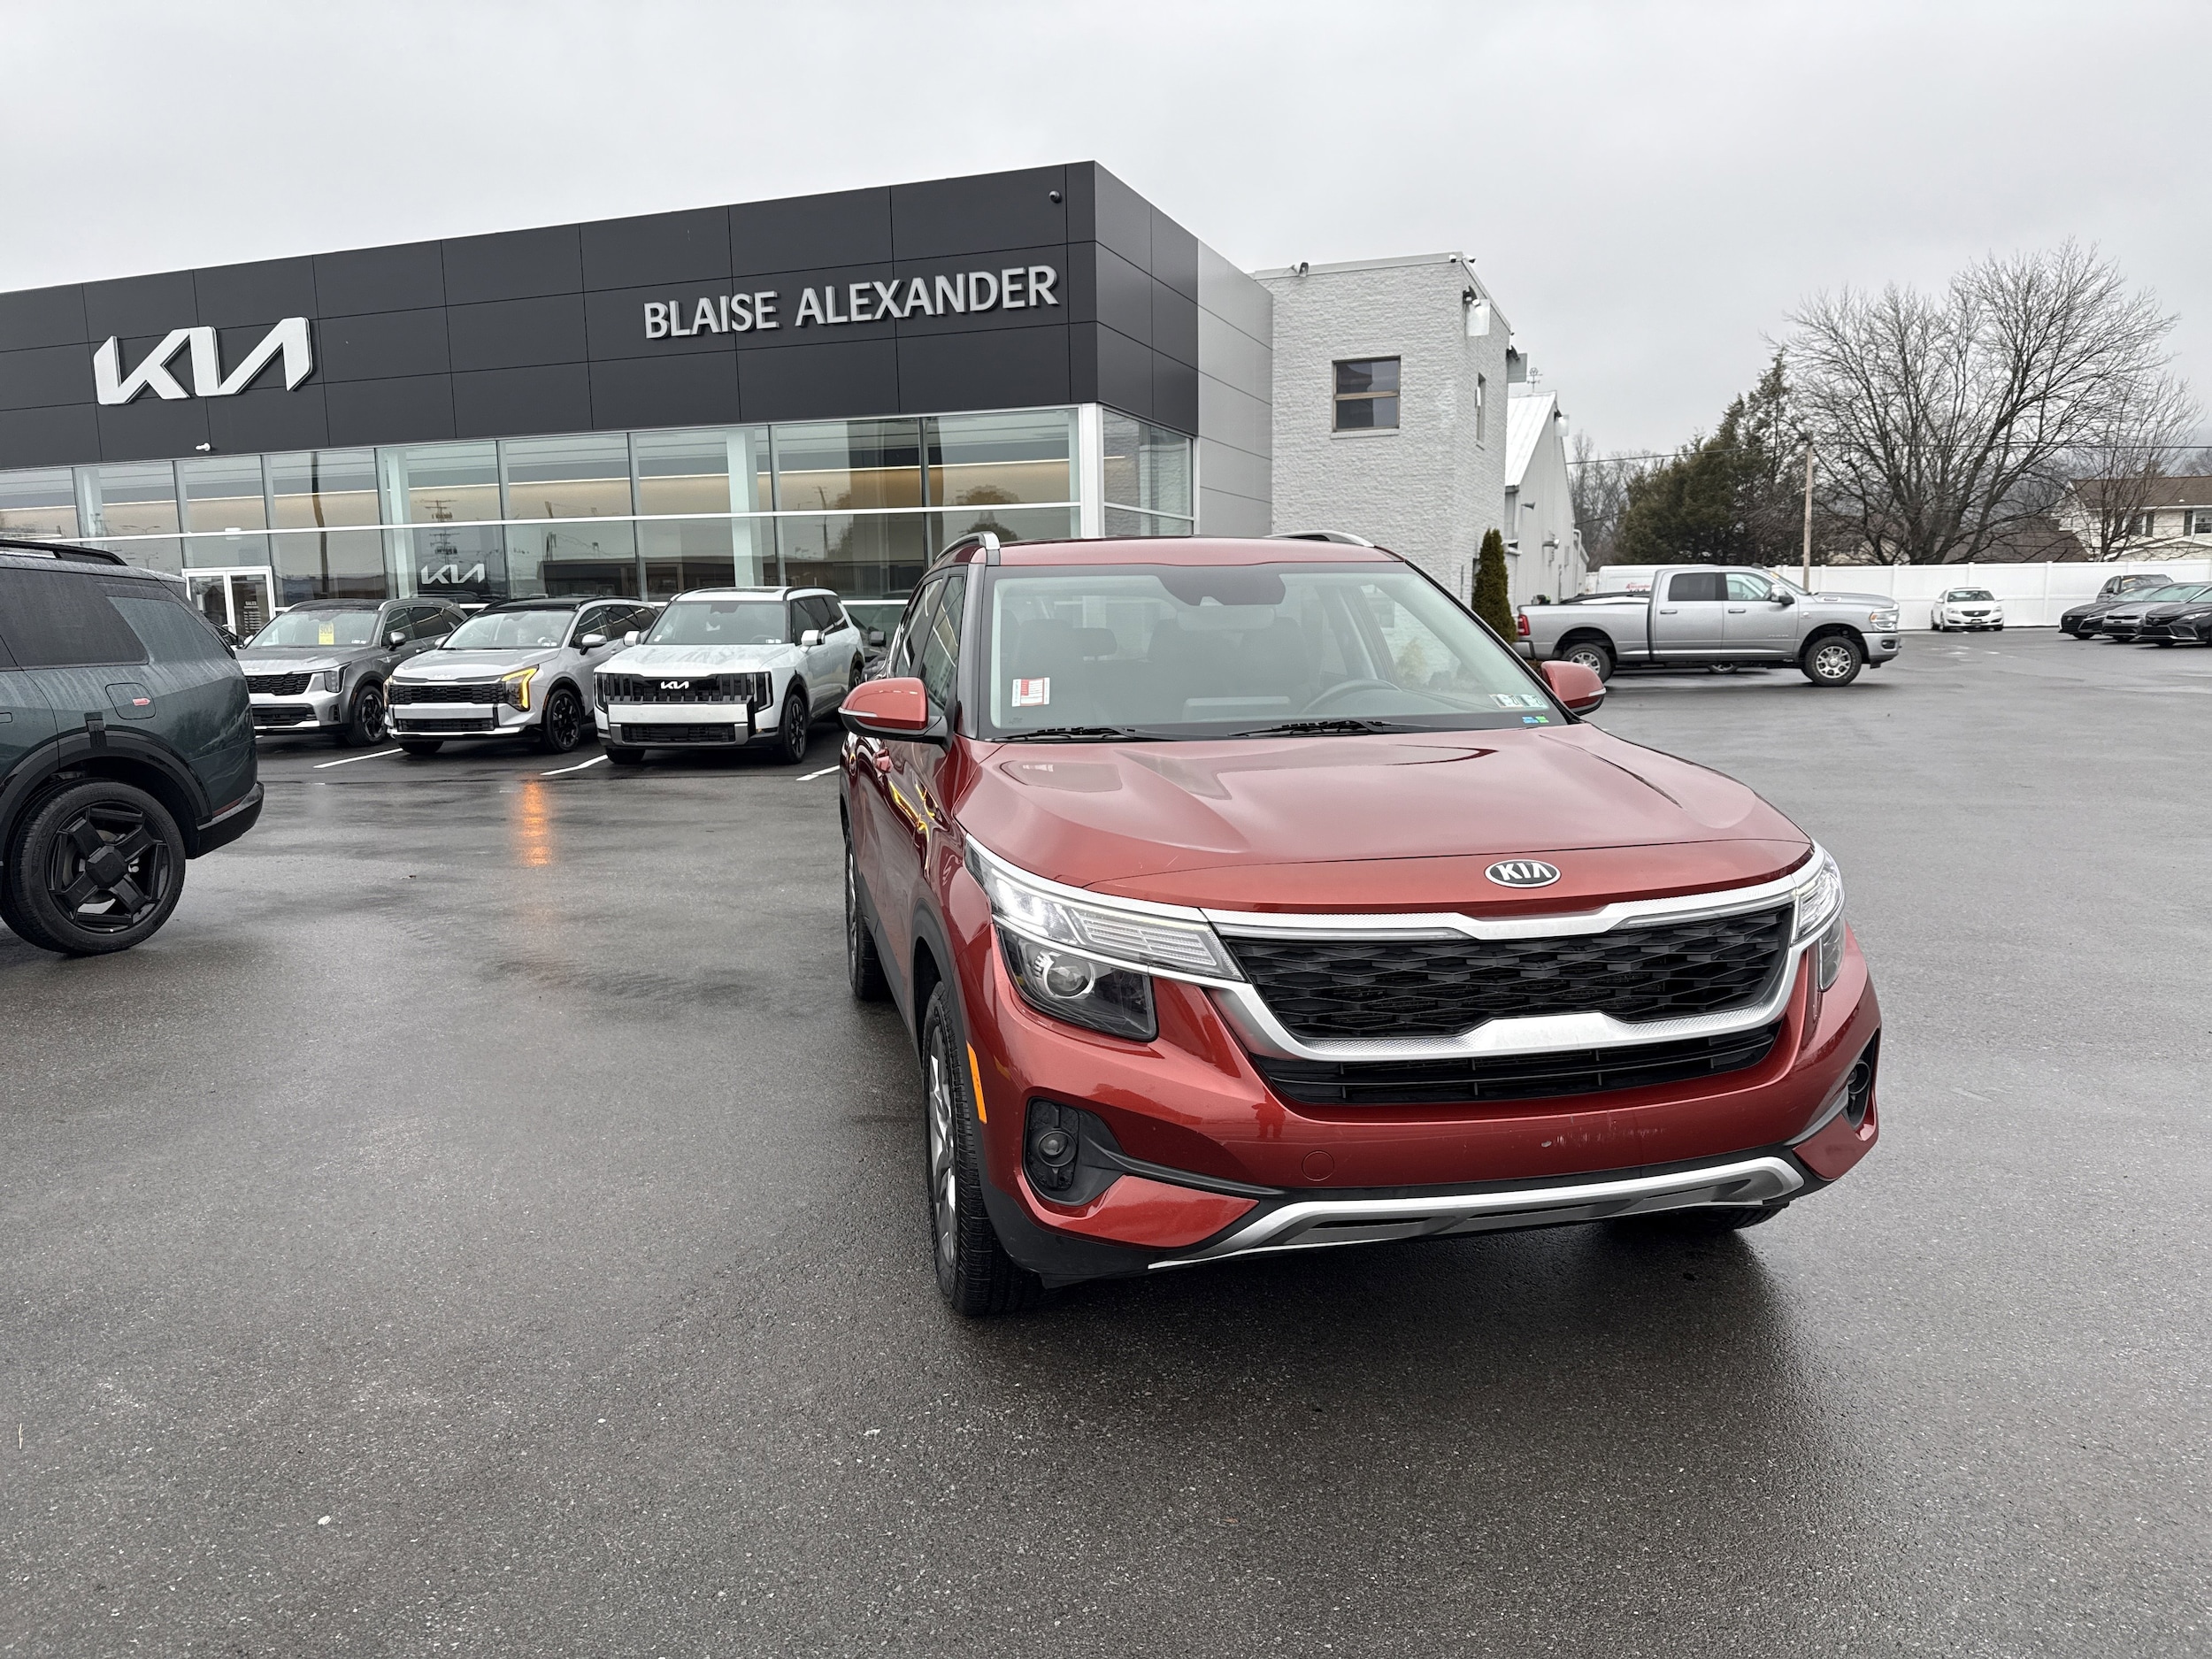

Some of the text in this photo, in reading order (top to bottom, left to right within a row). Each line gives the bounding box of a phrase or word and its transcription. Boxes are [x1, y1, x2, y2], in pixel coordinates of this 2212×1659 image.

[643, 265, 1060, 339] BLAISE ALEXANDER
[93, 316, 313, 405] KIA
[420, 563, 486, 585] KIA
[660, 680, 689, 689] KIA
[1494, 862, 1554, 881] KIA
